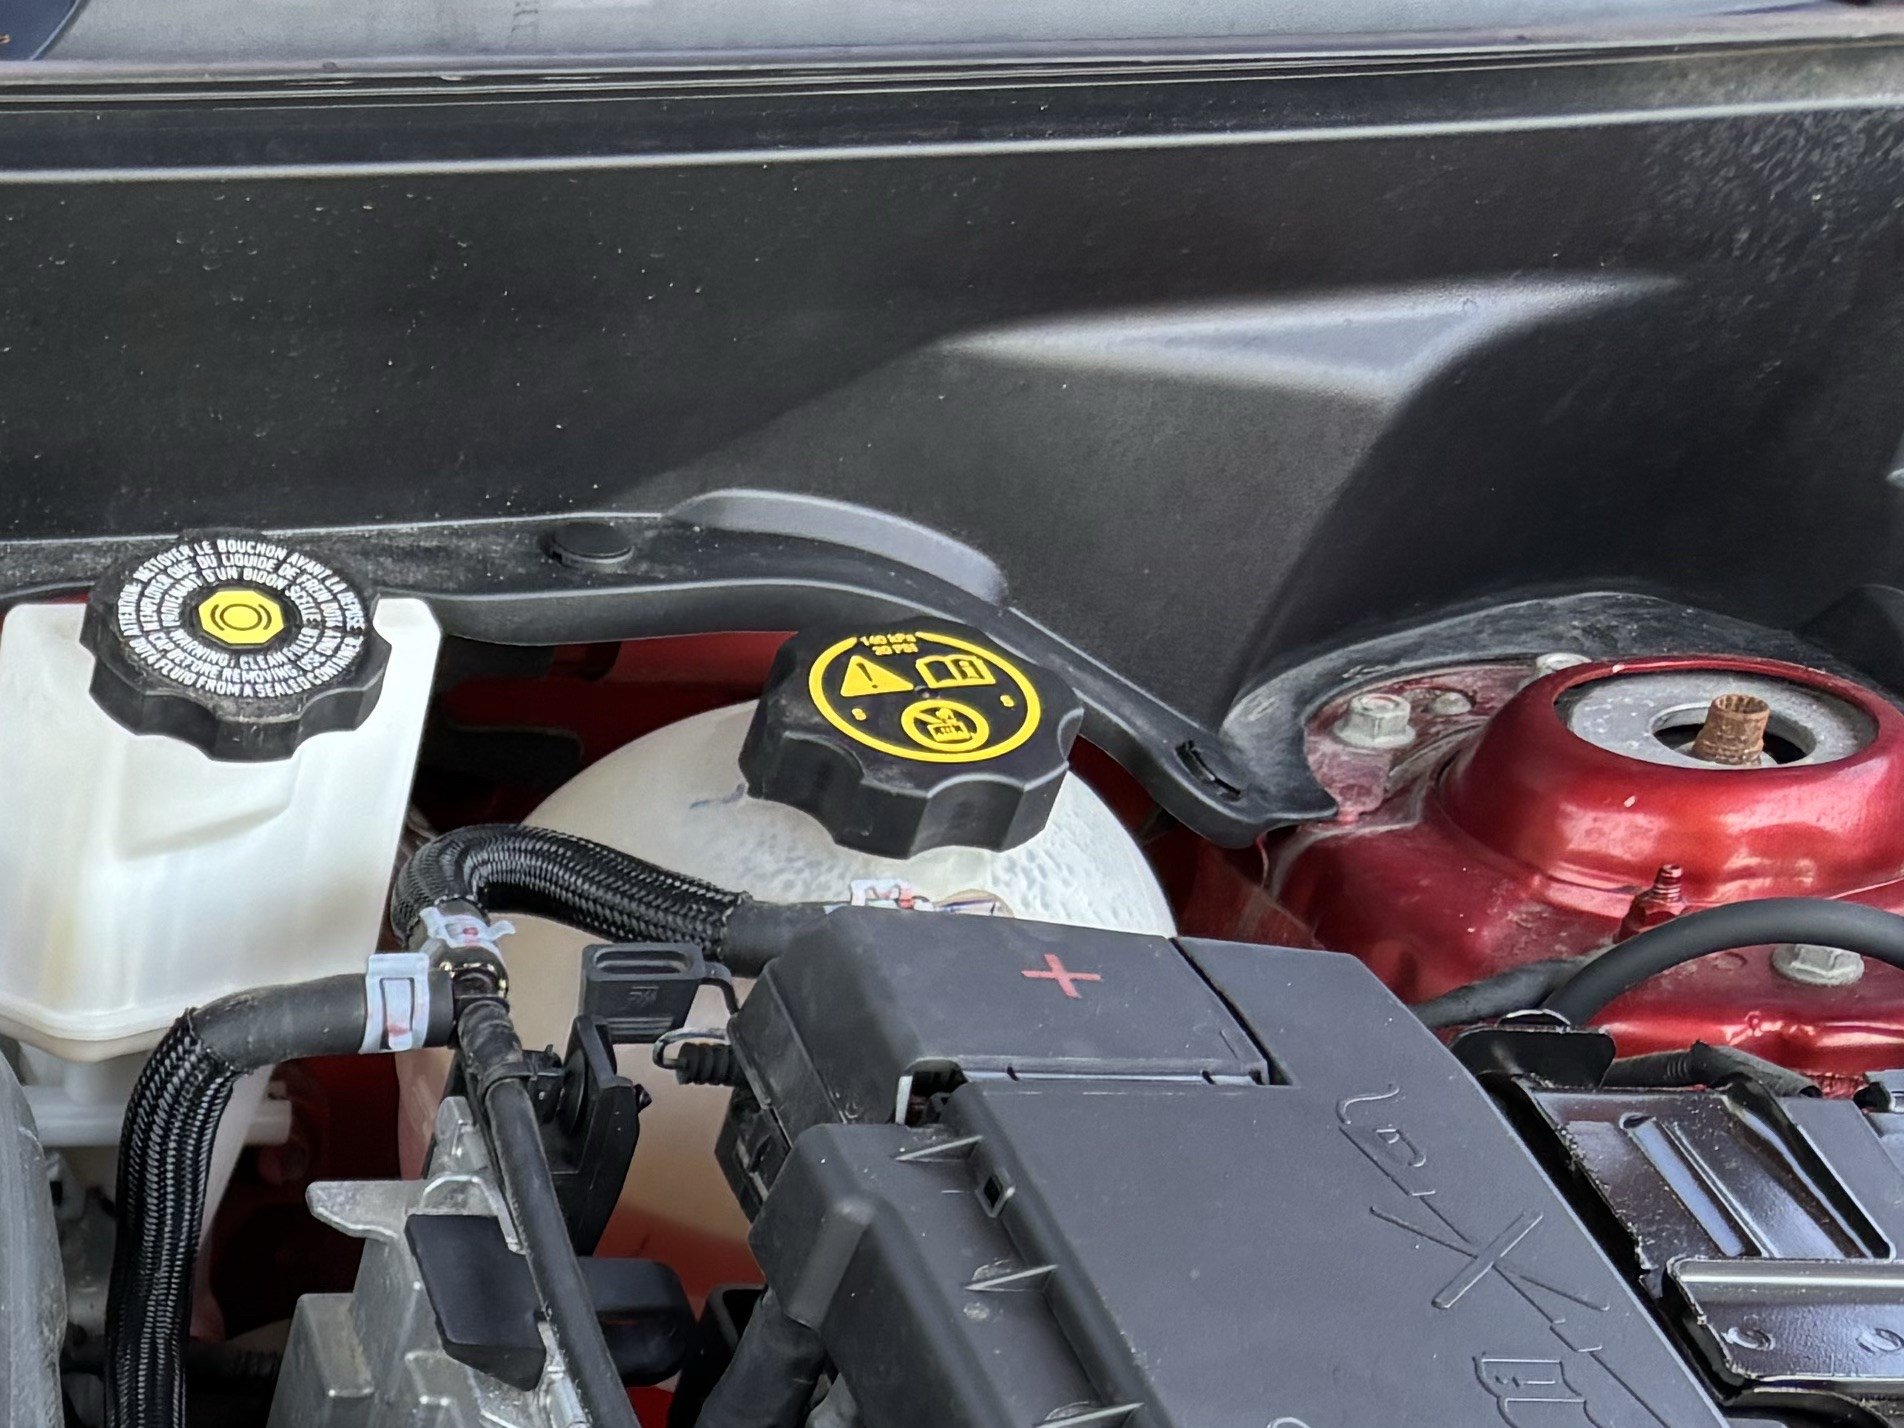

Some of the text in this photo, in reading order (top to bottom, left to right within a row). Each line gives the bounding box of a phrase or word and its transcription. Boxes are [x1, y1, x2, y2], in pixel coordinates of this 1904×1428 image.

[194, 541, 214, 555] LE
[217, 539, 287, 560] BOUCHON
[287, 552, 333, 579] AVANT
[325, 576, 347, 593] LA
[196, 555, 217, 568] DU
[221, 553, 277, 572] LIQUIDE
[278, 563, 300, 580] DE
[202, 567, 238, 582] D'UN
[243, 567, 290, 590] BIDON
[166, 648, 222, 679] BEFORE
[240, 650, 290, 670] CLEAN
[154, 658, 196, 686] FLUID
[195, 675, 239, 696] FROM
[242, 684, 254, 698] A
[254, 676, 312, 698] SEALED
